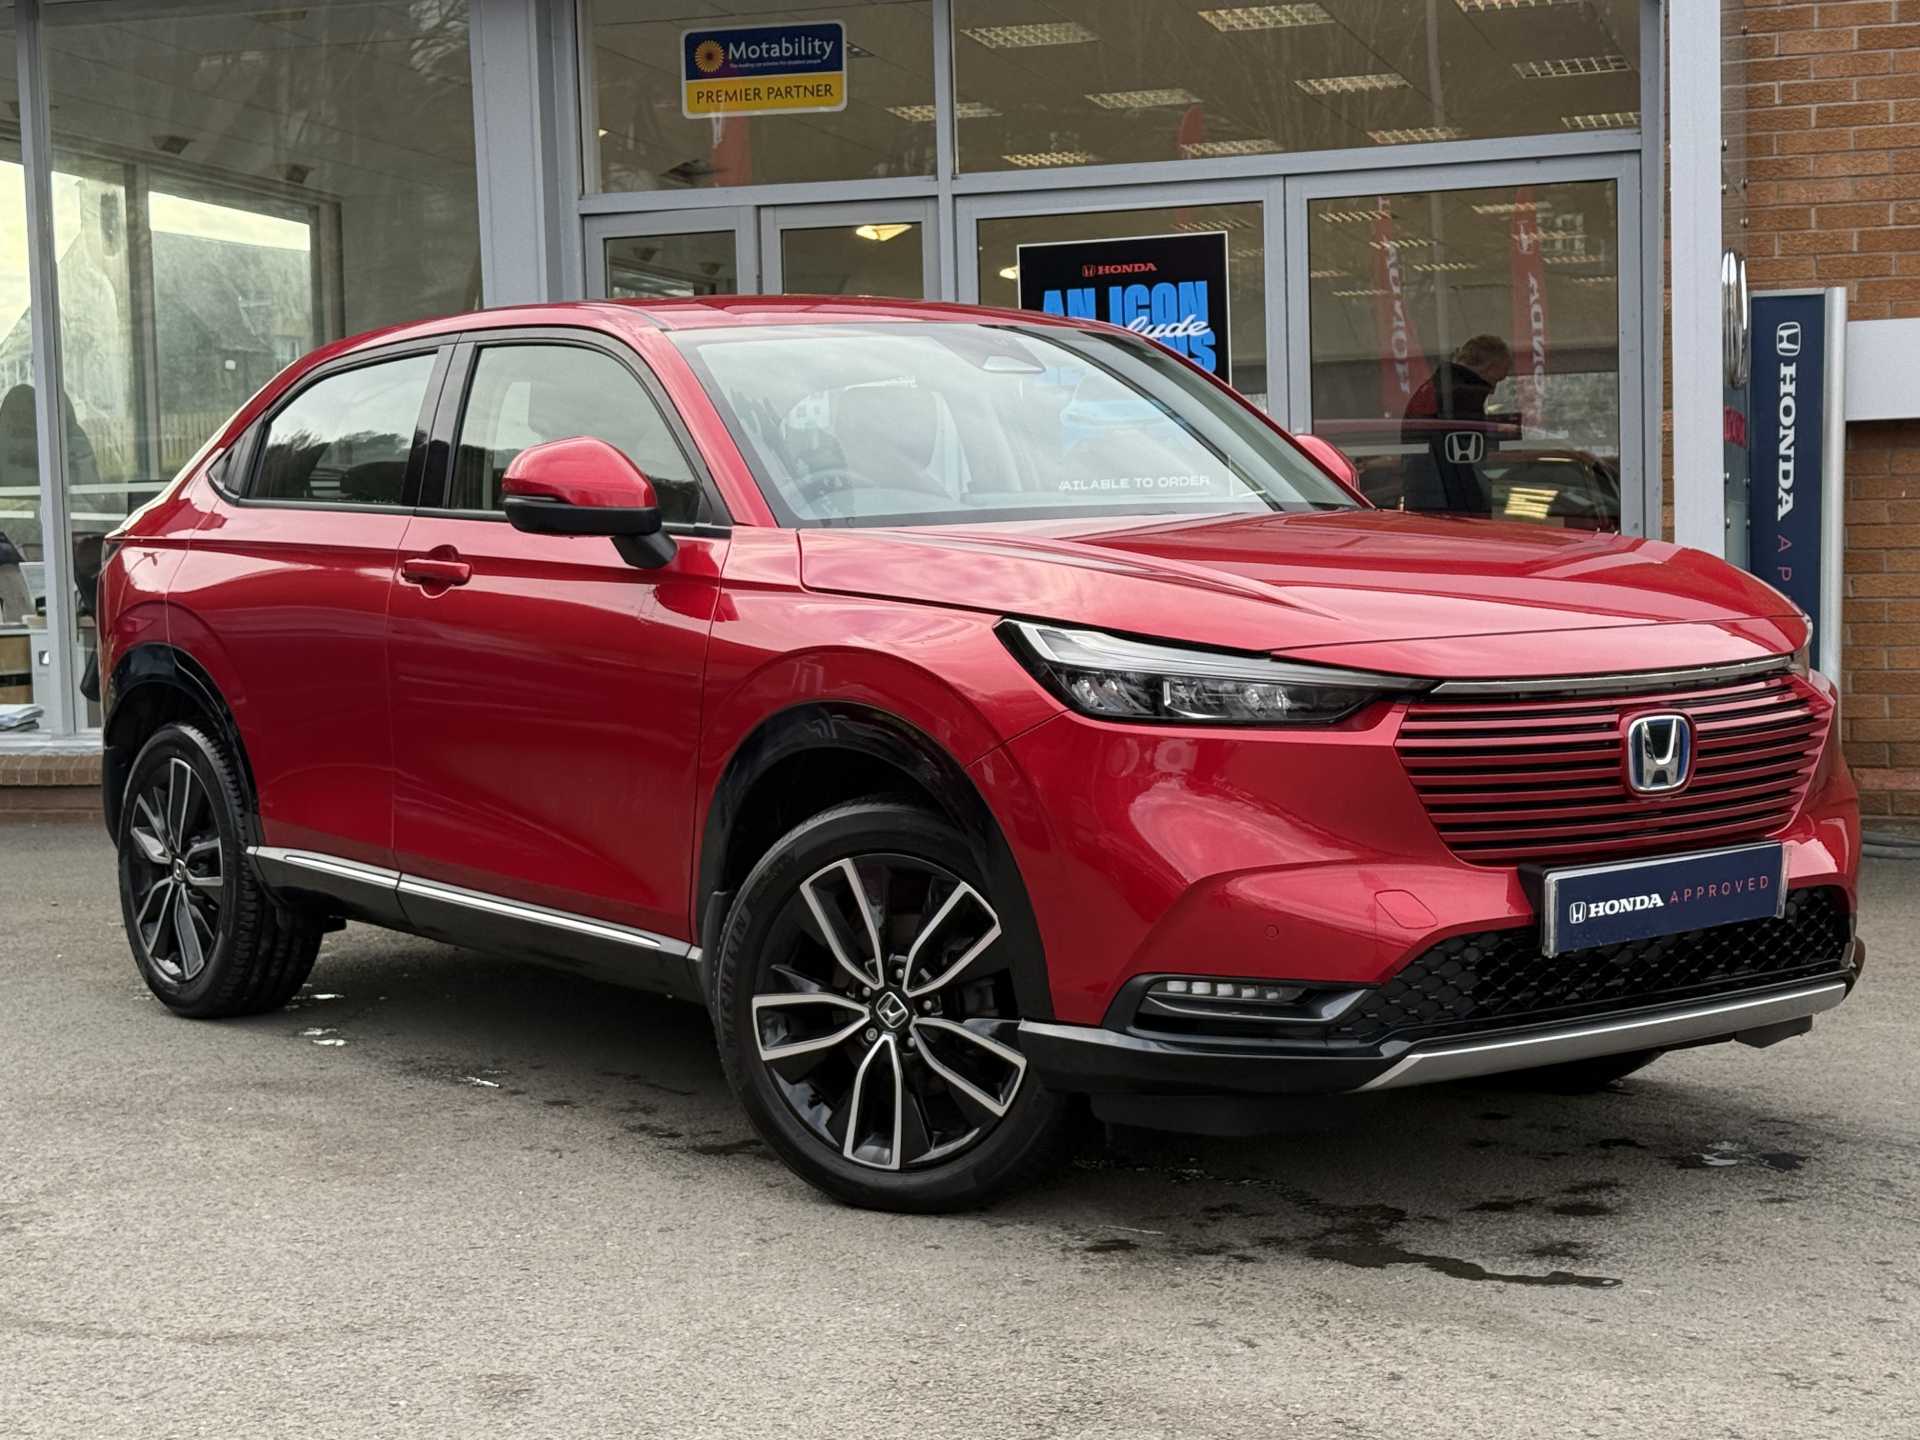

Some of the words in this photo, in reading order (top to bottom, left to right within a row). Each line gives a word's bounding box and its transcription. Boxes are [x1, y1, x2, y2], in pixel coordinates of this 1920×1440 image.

[728, 36, 834, 60] Motability
[696, 87, 763, 105] PREMIER
[767, 83, 834, 101] PARTNER
[1097, 262, 1158, 275] HONDA
[1043, 287, 1096, 320] AN
[1108, 280, 1209, 326] ICON
[1776, 362, 1797, 521] HONDA
[1134, 476, 1153, 488] TO
[1158, 474, 1210, 488] ORDER
[1588, 893, 1664, 918] HONDA
[1669, 875, 1769, 905] APPROVED
